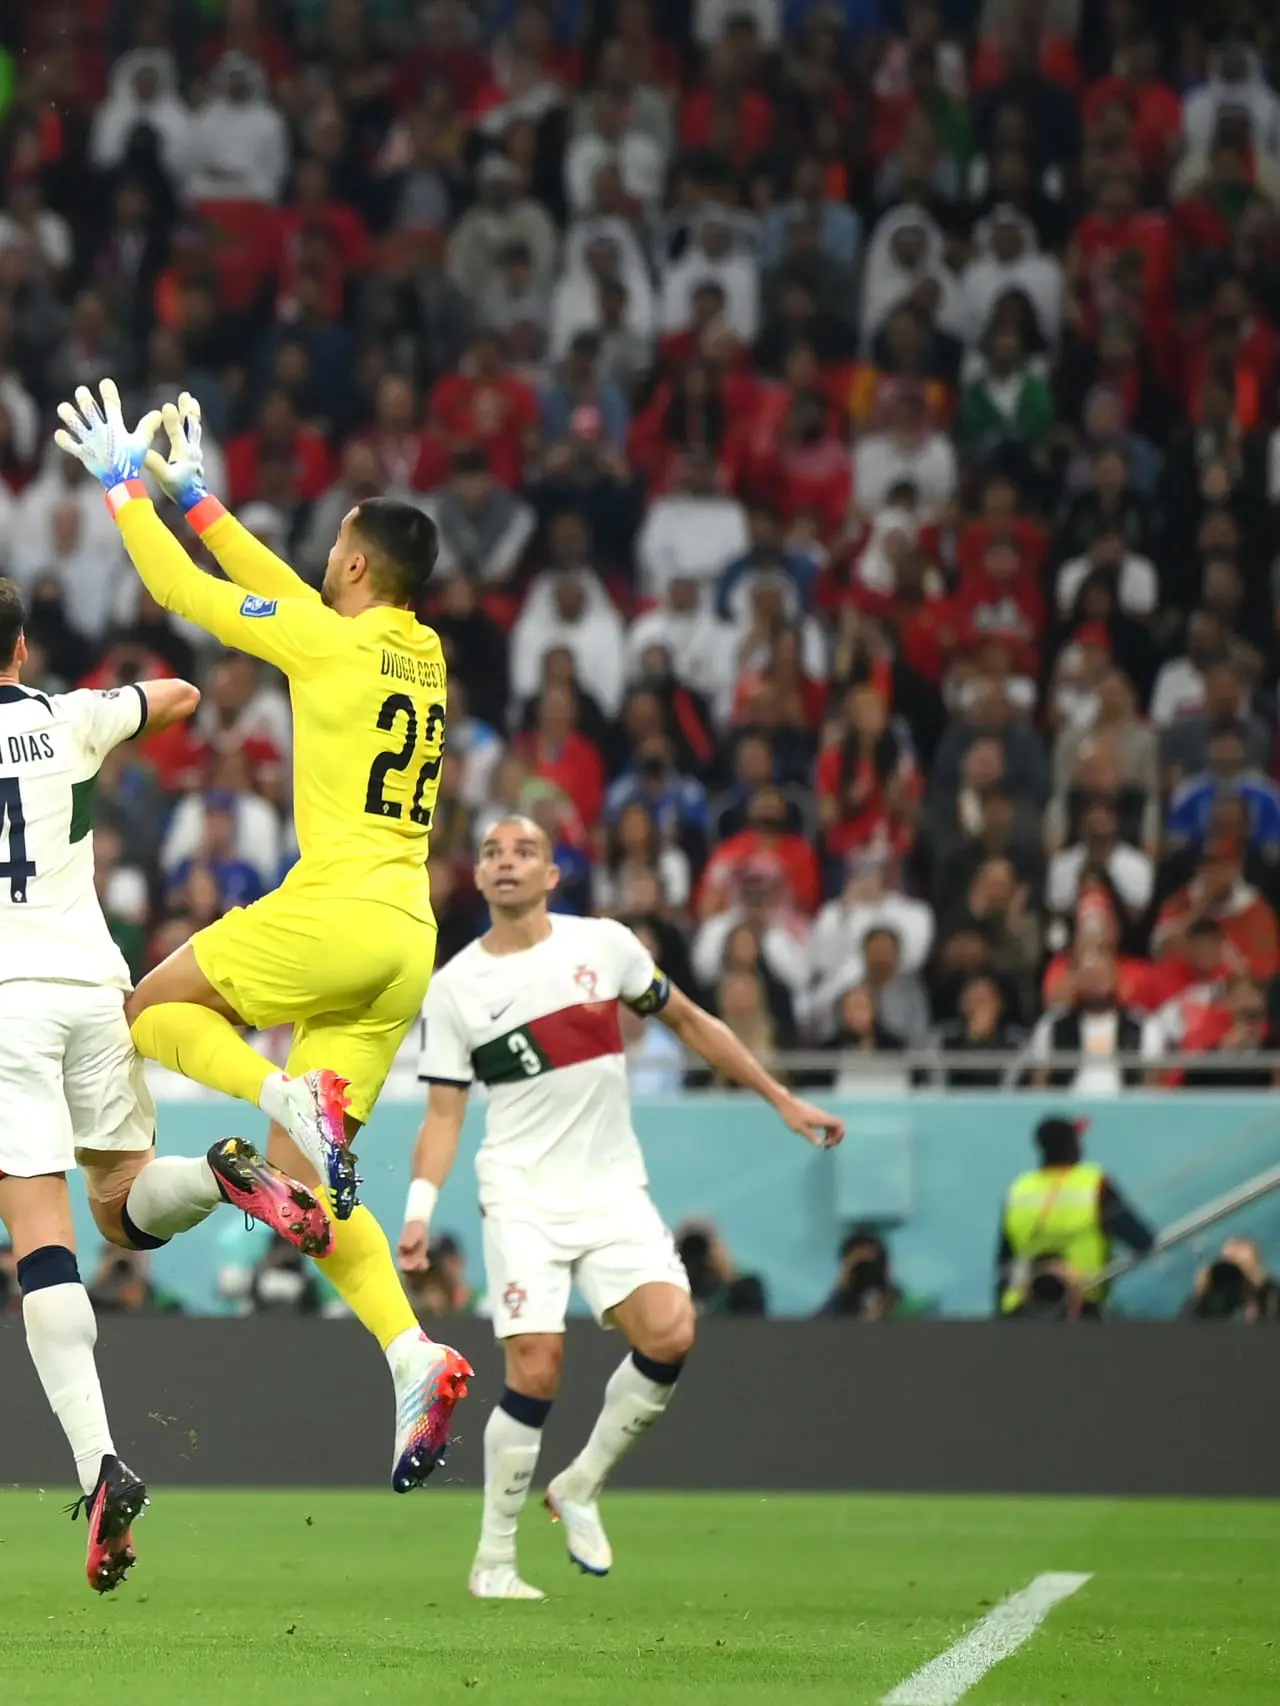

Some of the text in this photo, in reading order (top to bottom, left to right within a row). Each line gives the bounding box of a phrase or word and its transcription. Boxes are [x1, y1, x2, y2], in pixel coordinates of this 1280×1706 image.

[381, 649, 416, 684] DIOGO
[8, 733, 55, 764] DIAS
[364, 693, 445, 826] 22
[507, 1032, 542, 1076] 3
